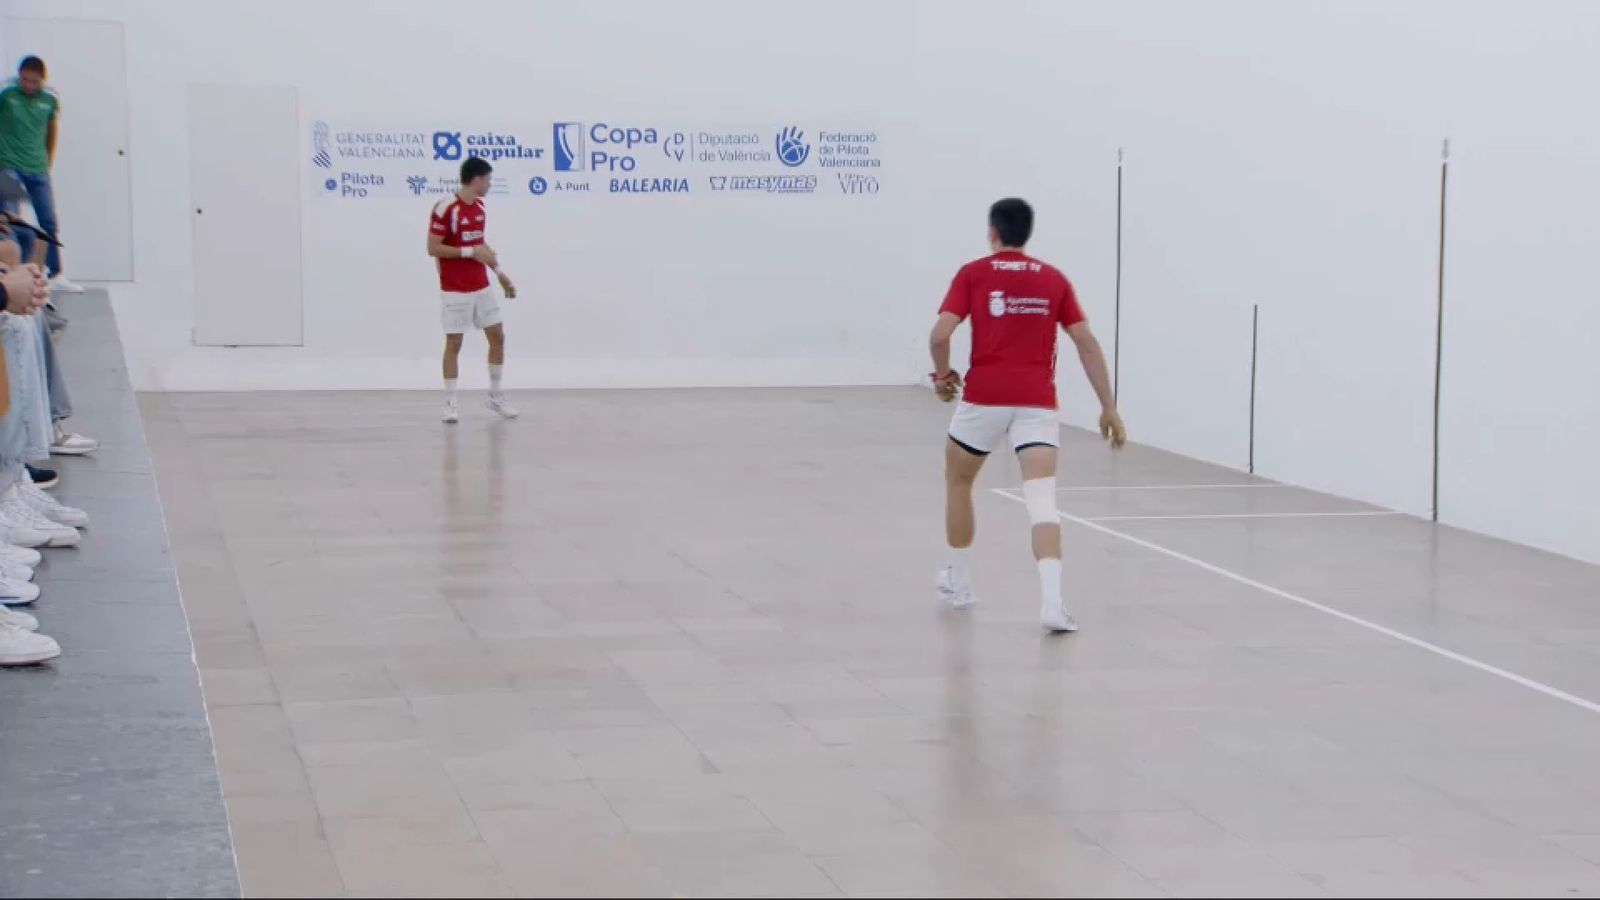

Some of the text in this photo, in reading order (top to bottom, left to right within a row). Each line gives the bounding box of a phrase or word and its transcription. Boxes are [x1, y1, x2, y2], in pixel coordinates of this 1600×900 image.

[336, 133, 425, 145] GENERALITAT
[466, 132, 516, 146] caixa
[590, 122, 658, 149] Copa
[337, 147, 425, 159] VALENCIANA
[467, 145, 545, 160] popular
[699, 149, 716, 161] de
[819, 143, 869, 155] de Pilota
[591, 151, 636, 172] Pro
[819, 156, 881, 168] Valenciana
[341, 172, 384, 186] Pilota
[730, 175, 818, 193] masymas
[342, 184, 368, 198] Pro
[566, 182, 591, 191] Punt
